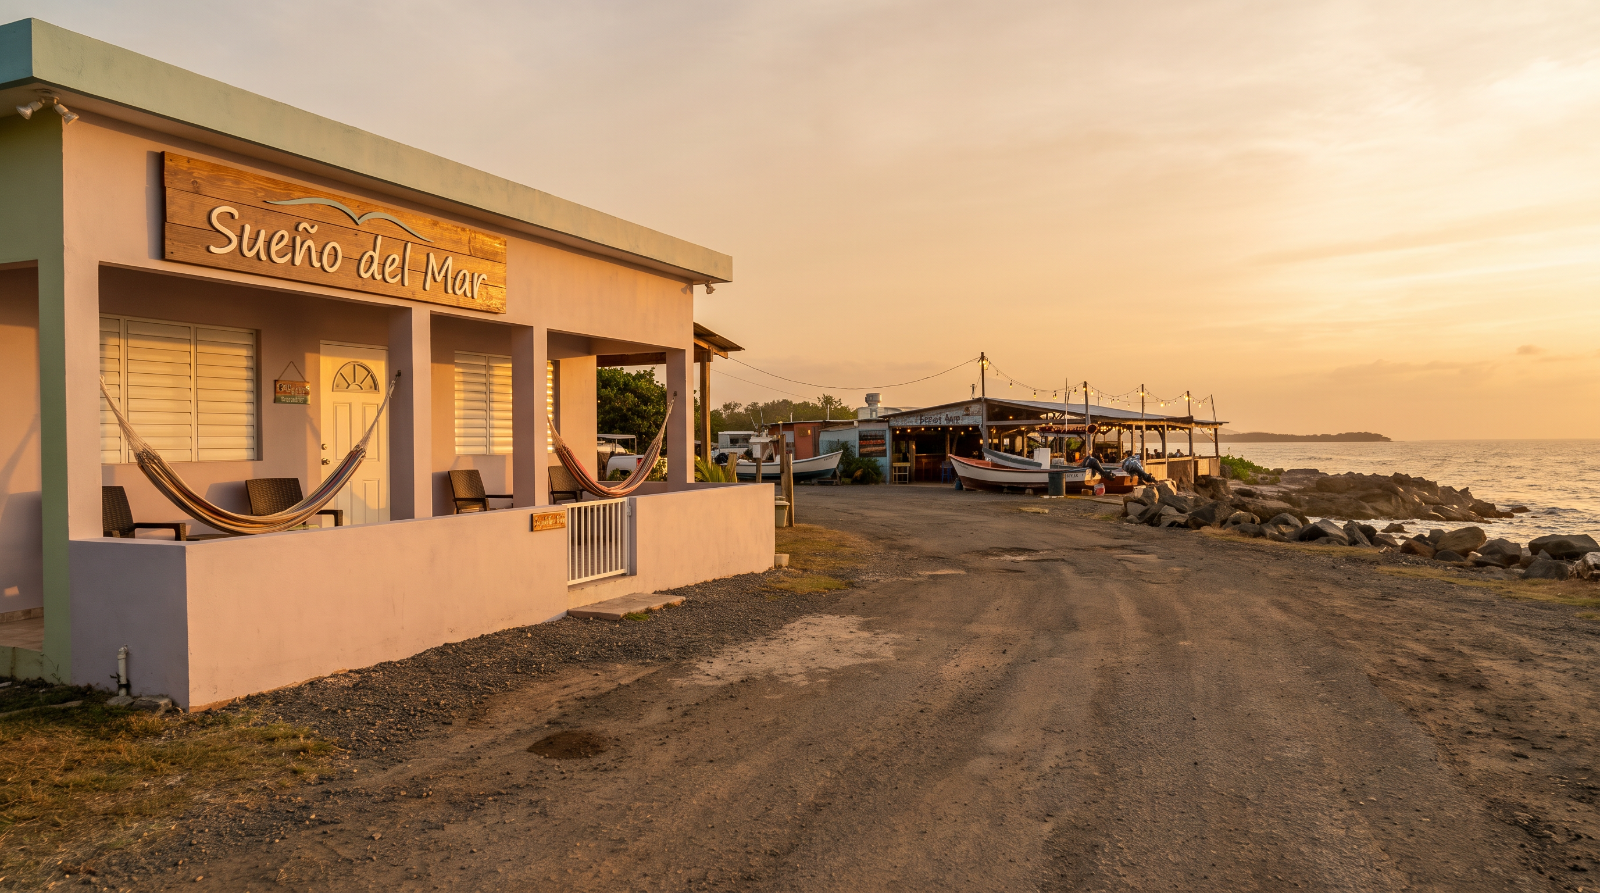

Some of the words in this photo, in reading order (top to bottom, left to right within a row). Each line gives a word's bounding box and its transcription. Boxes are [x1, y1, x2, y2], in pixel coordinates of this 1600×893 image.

[209, 205, 343, 273] Sueño
[358, 235, 412, 287] del
[423, 252, 488, 300] Mar
